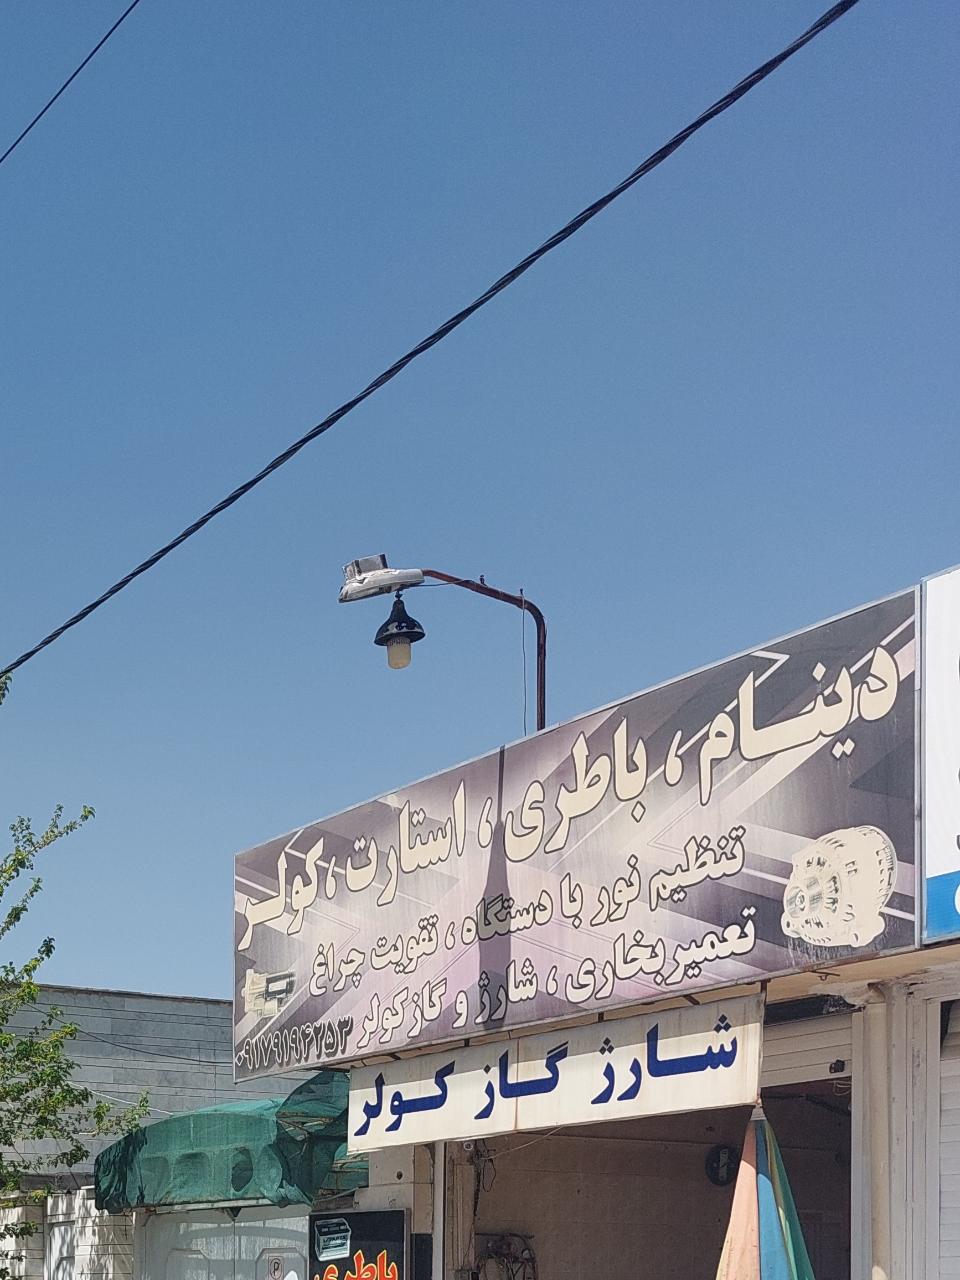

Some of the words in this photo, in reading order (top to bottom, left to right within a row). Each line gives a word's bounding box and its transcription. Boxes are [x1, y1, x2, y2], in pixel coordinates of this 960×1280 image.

[699, 646, 899, 806] دینام
[504, 716, 648, 863] باطری
[345, 779, 467, 907] استارت
[648, 824, 747, 911] تنظیم
[237, 837, 325, 952] کولر
[461, 890, 554, 945] دستگاه
[560, 873, 583, 929] با
[589, 854, 641, 927] نور
[309, 943, 366, 997] چراغ
[371, 914, 438, 974] تقویت
[452, 991, 468, 1029] و
[474, 958, 538, 1024] شارژ
[474, 1041, 569, 1121] گاز
[590, 1014, 738, 1105] شارژ
[354, 1060, 456, 1137] کولر
